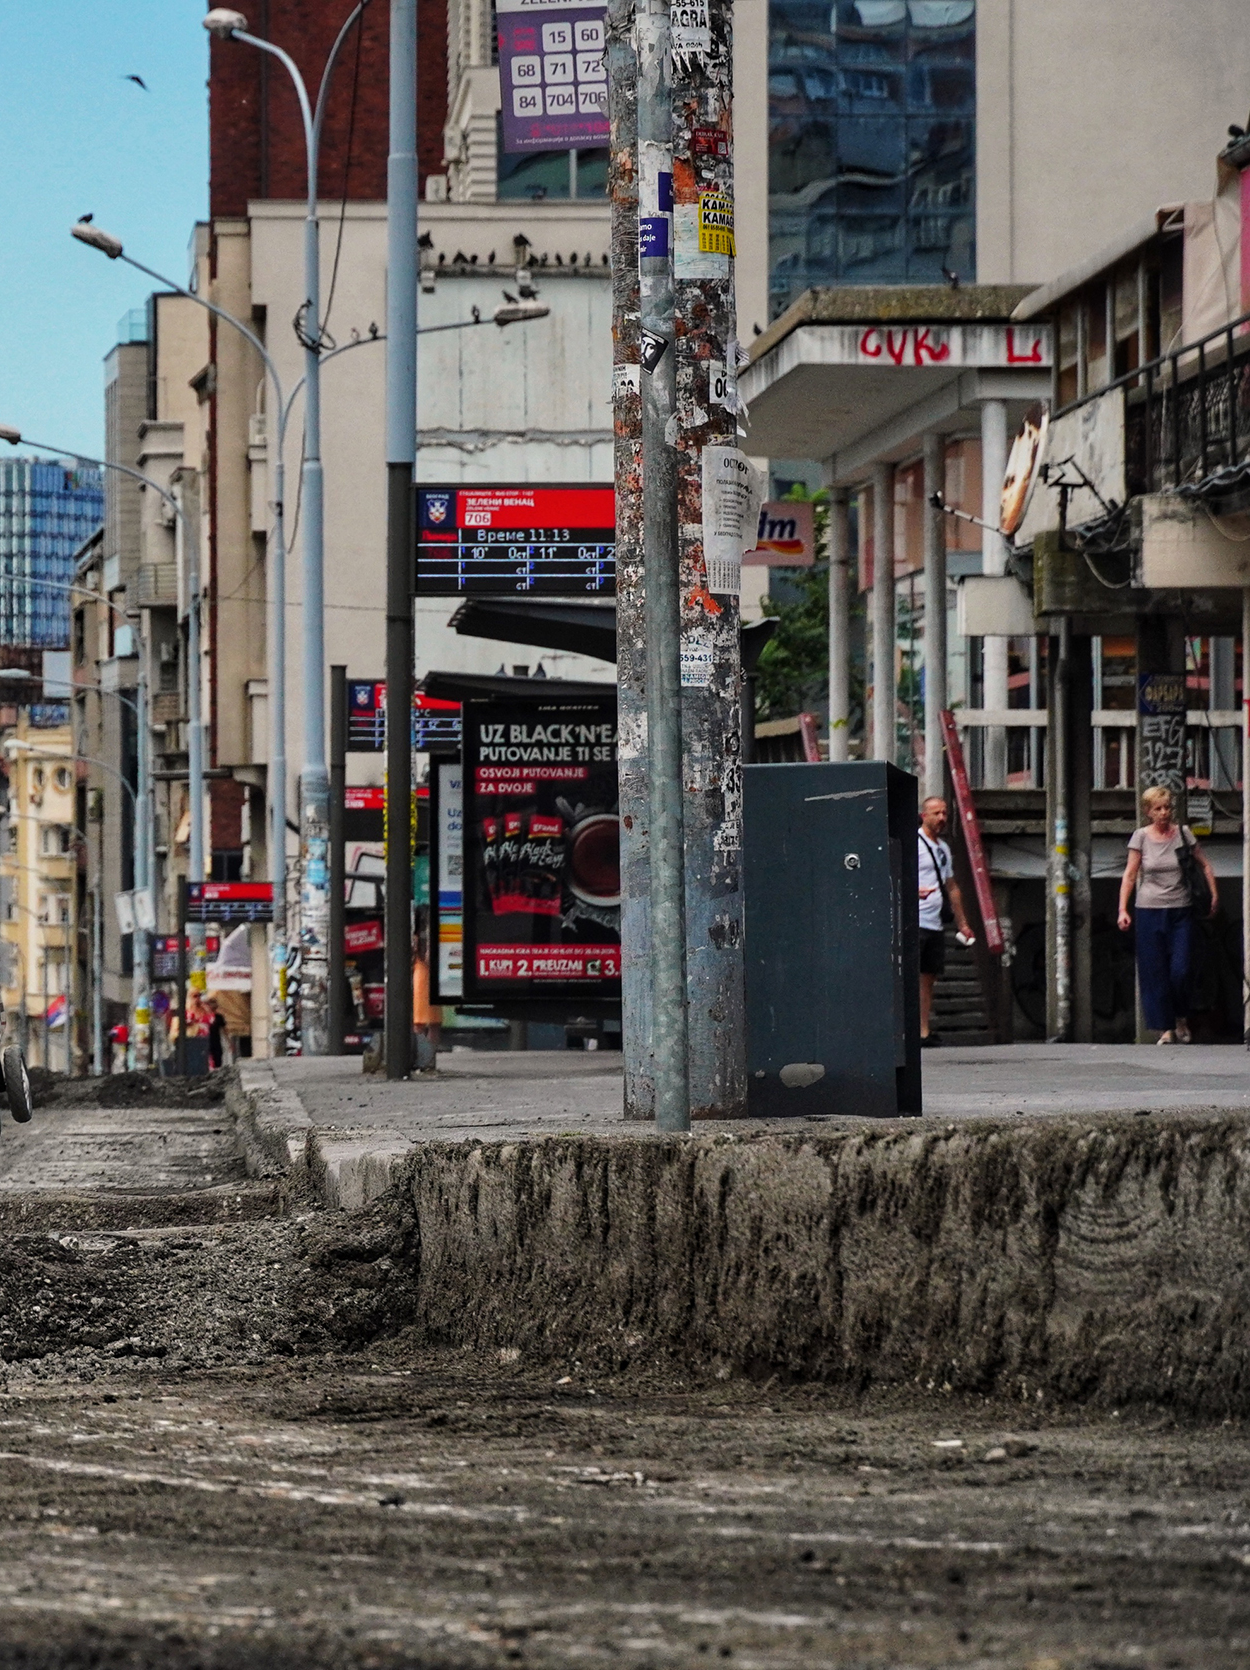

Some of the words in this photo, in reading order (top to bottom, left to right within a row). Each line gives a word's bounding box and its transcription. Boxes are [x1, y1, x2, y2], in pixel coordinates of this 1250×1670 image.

[549, 31, 566, 44] 15
[581, 28, 599, 42] 60
[517, 64, 536, 77] 68
[550, 62, 567, 75] 71
[582, 60, 601, 74] 72
[519, 96, 537, 109] 84
[547, 93, 574, 107] 704
[579, 91, 607, 105] 706
[466, 513, 490, 524] 706
[477, 529, 525, 543] Време
[529, 529, 570, 541] 11:13
[479, 724, 505, 743] UZ
[479, 747, 572, 761] PUTOVANJE
[575, 747, 589, 761] TI
[593, 747, 611, 761] SE
[480, 767, 520, 778] OSVOJI
[522, 767, 585, 778] PUTOVANJE
[480, 783, 495, 793] ZA
[498, 783, 533, 793] DVOJE
[490, 959, 513, 970] KUPI
[517, 959, 532, 976] 2.
[533, 959, 583, 971] PREUZMI
[604, 959, 619, 976] 3.
